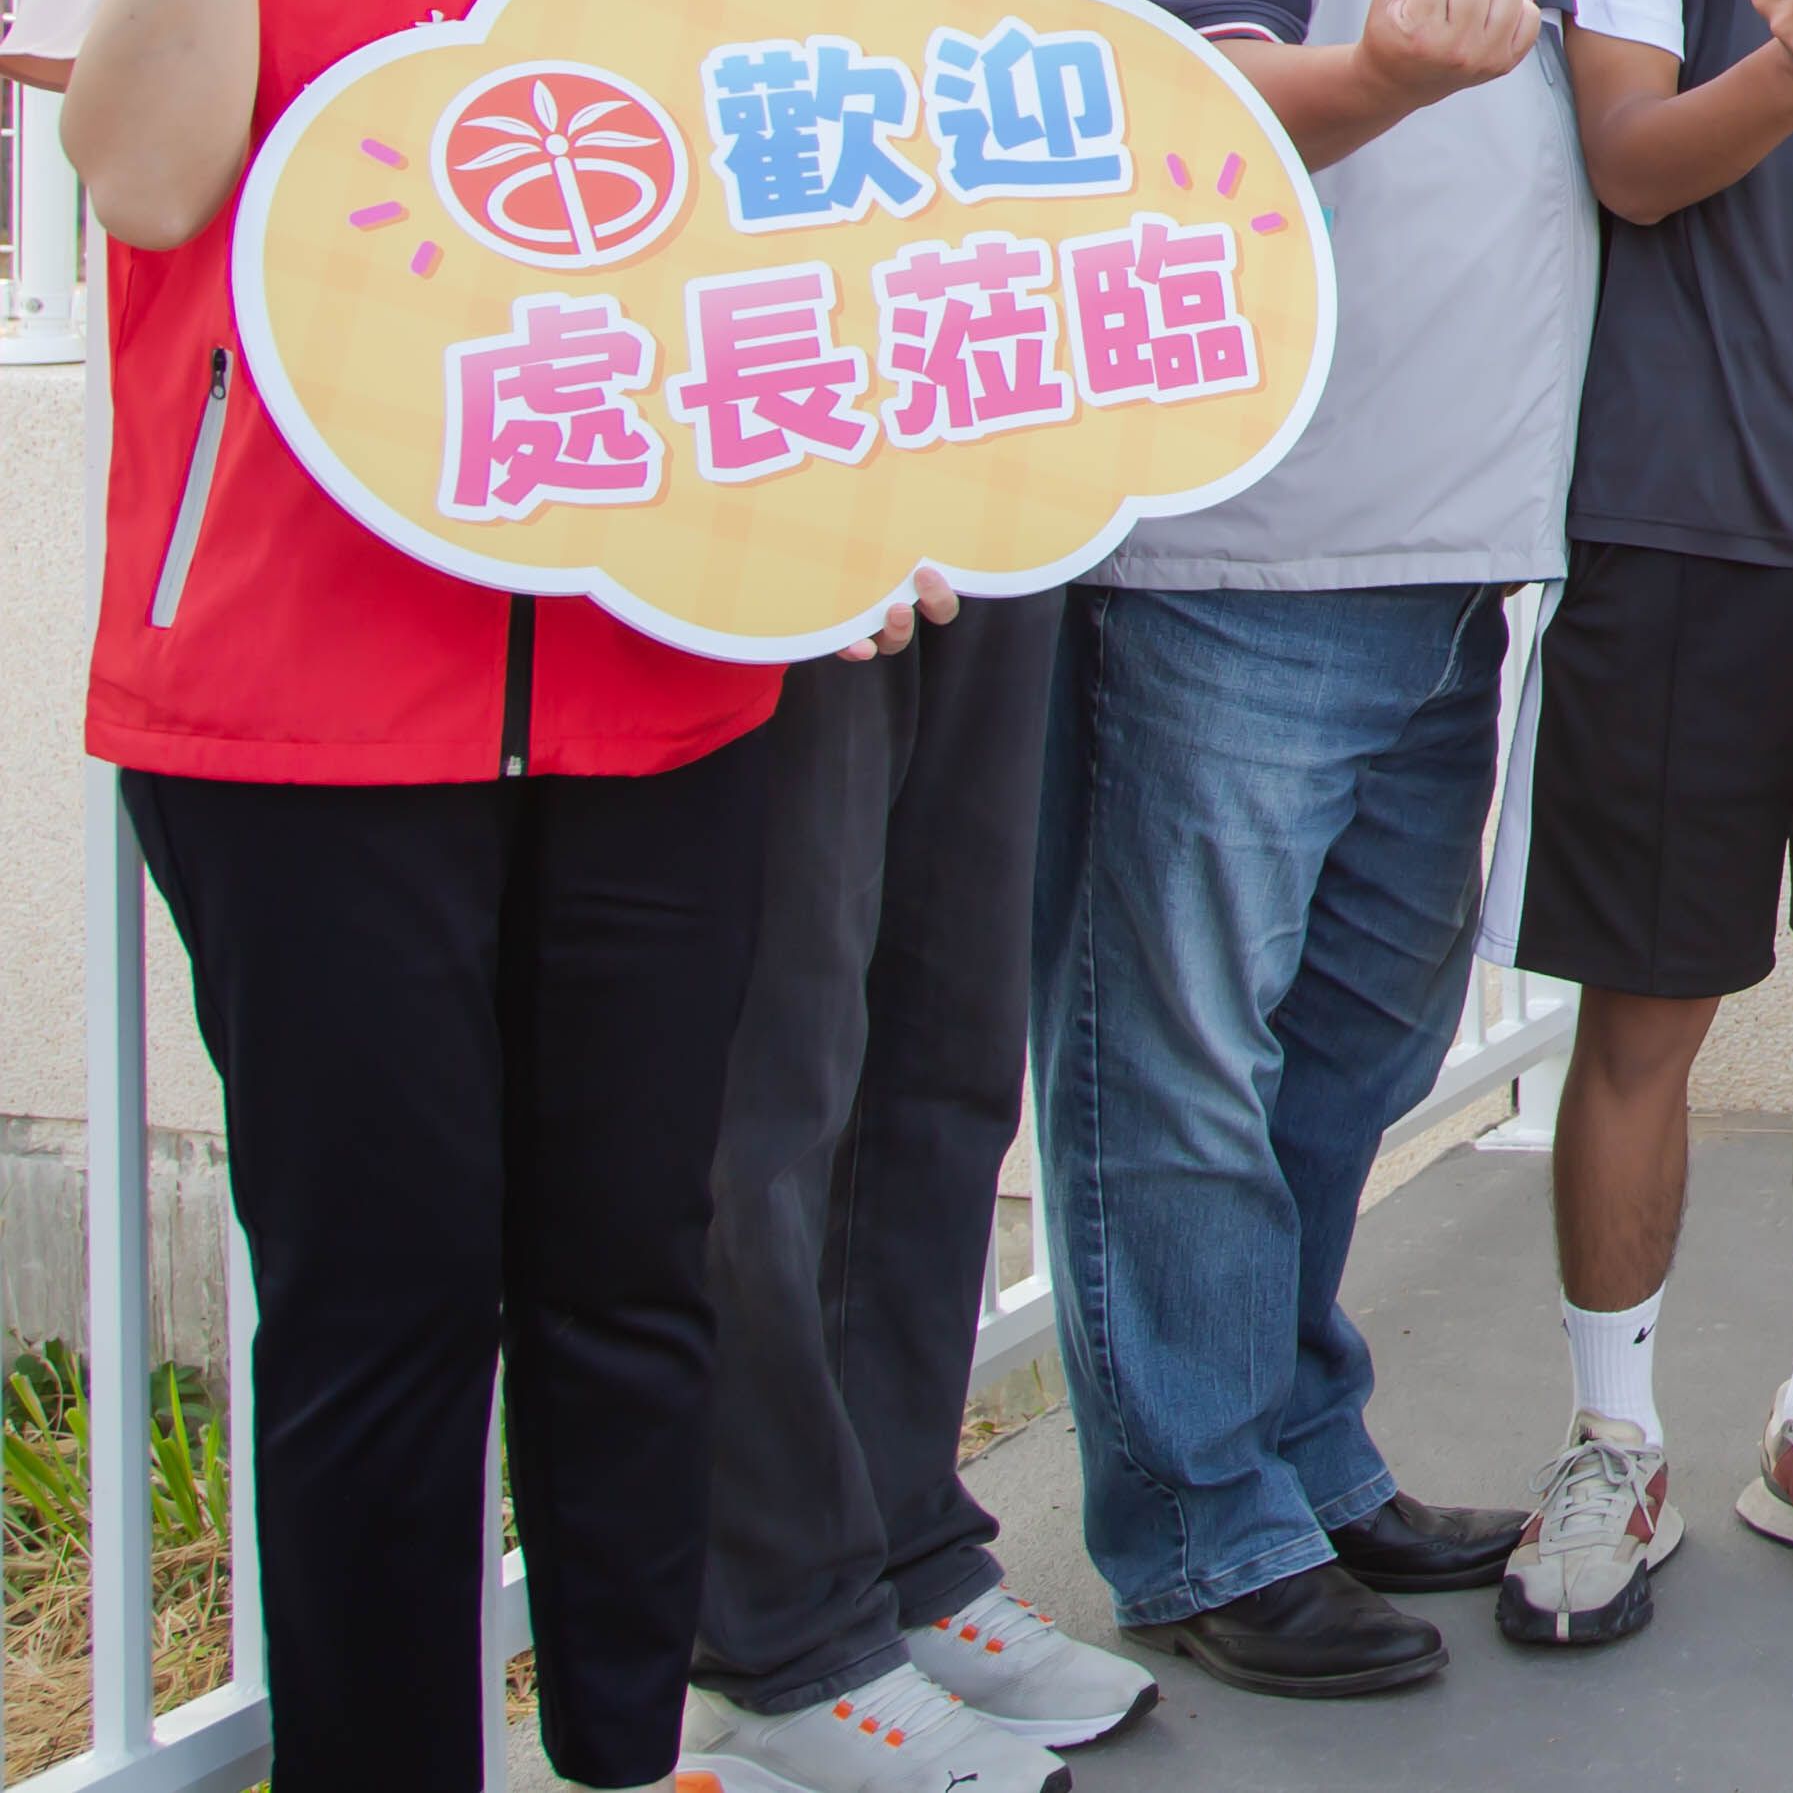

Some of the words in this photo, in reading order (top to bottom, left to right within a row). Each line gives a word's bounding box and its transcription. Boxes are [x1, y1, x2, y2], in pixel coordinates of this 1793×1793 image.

[709, 28, 1126, 223] 歡迎
[449, 222, 1250, 509] 處長蒞臨
